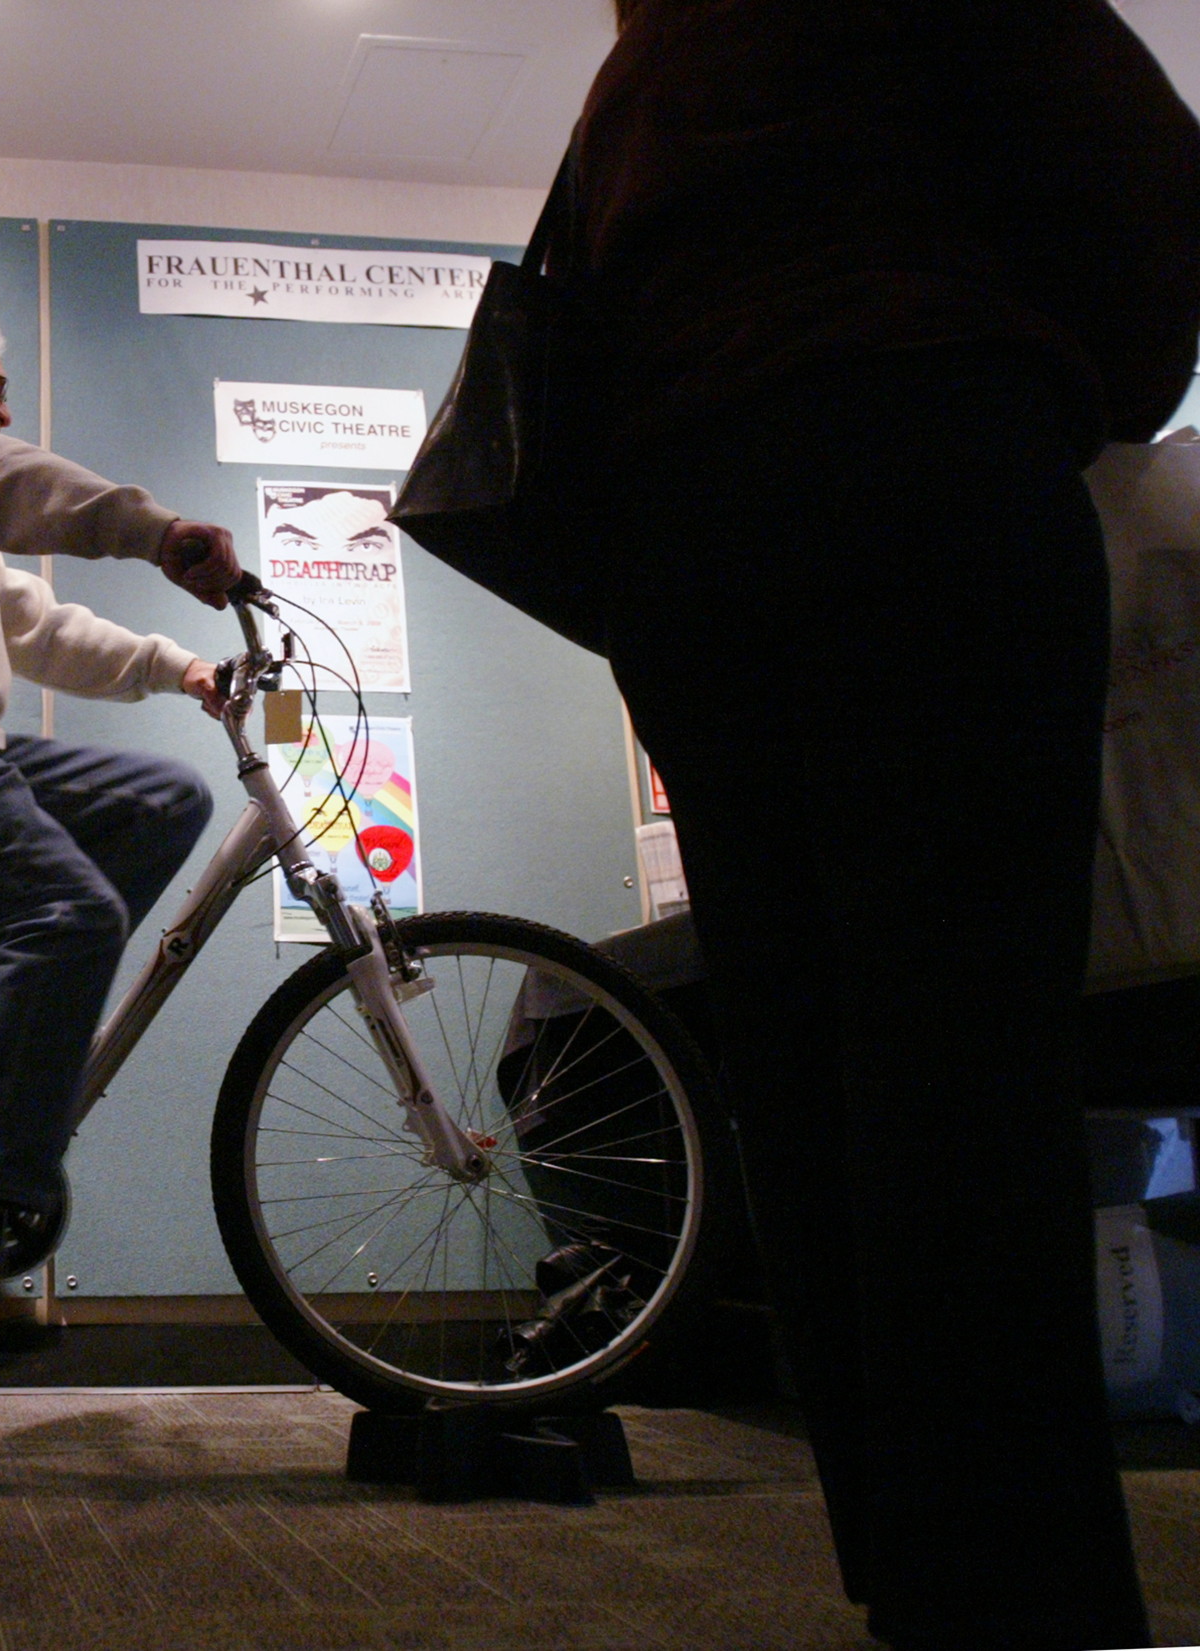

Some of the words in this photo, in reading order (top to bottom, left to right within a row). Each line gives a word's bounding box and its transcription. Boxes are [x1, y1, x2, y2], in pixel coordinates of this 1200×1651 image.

[146, 254, 357, 284] FRAUENTHAL
[365, 264, 486, 289] CENTER
[146, 278, 183, 288] FOR
[213, 280, 247, 291] THE
[271, 282, 415, 299] PERFORMING
[441, 289, 480, 300] ART
[261, 400, 364, 417] MUSKEGON
[278, 419, 325, 434] CIVIC
[331, 421, 412, 438] THEATRE
[320, 441, 366, 450] presents
[268, 559, 397, 582] DEATHTRAP
